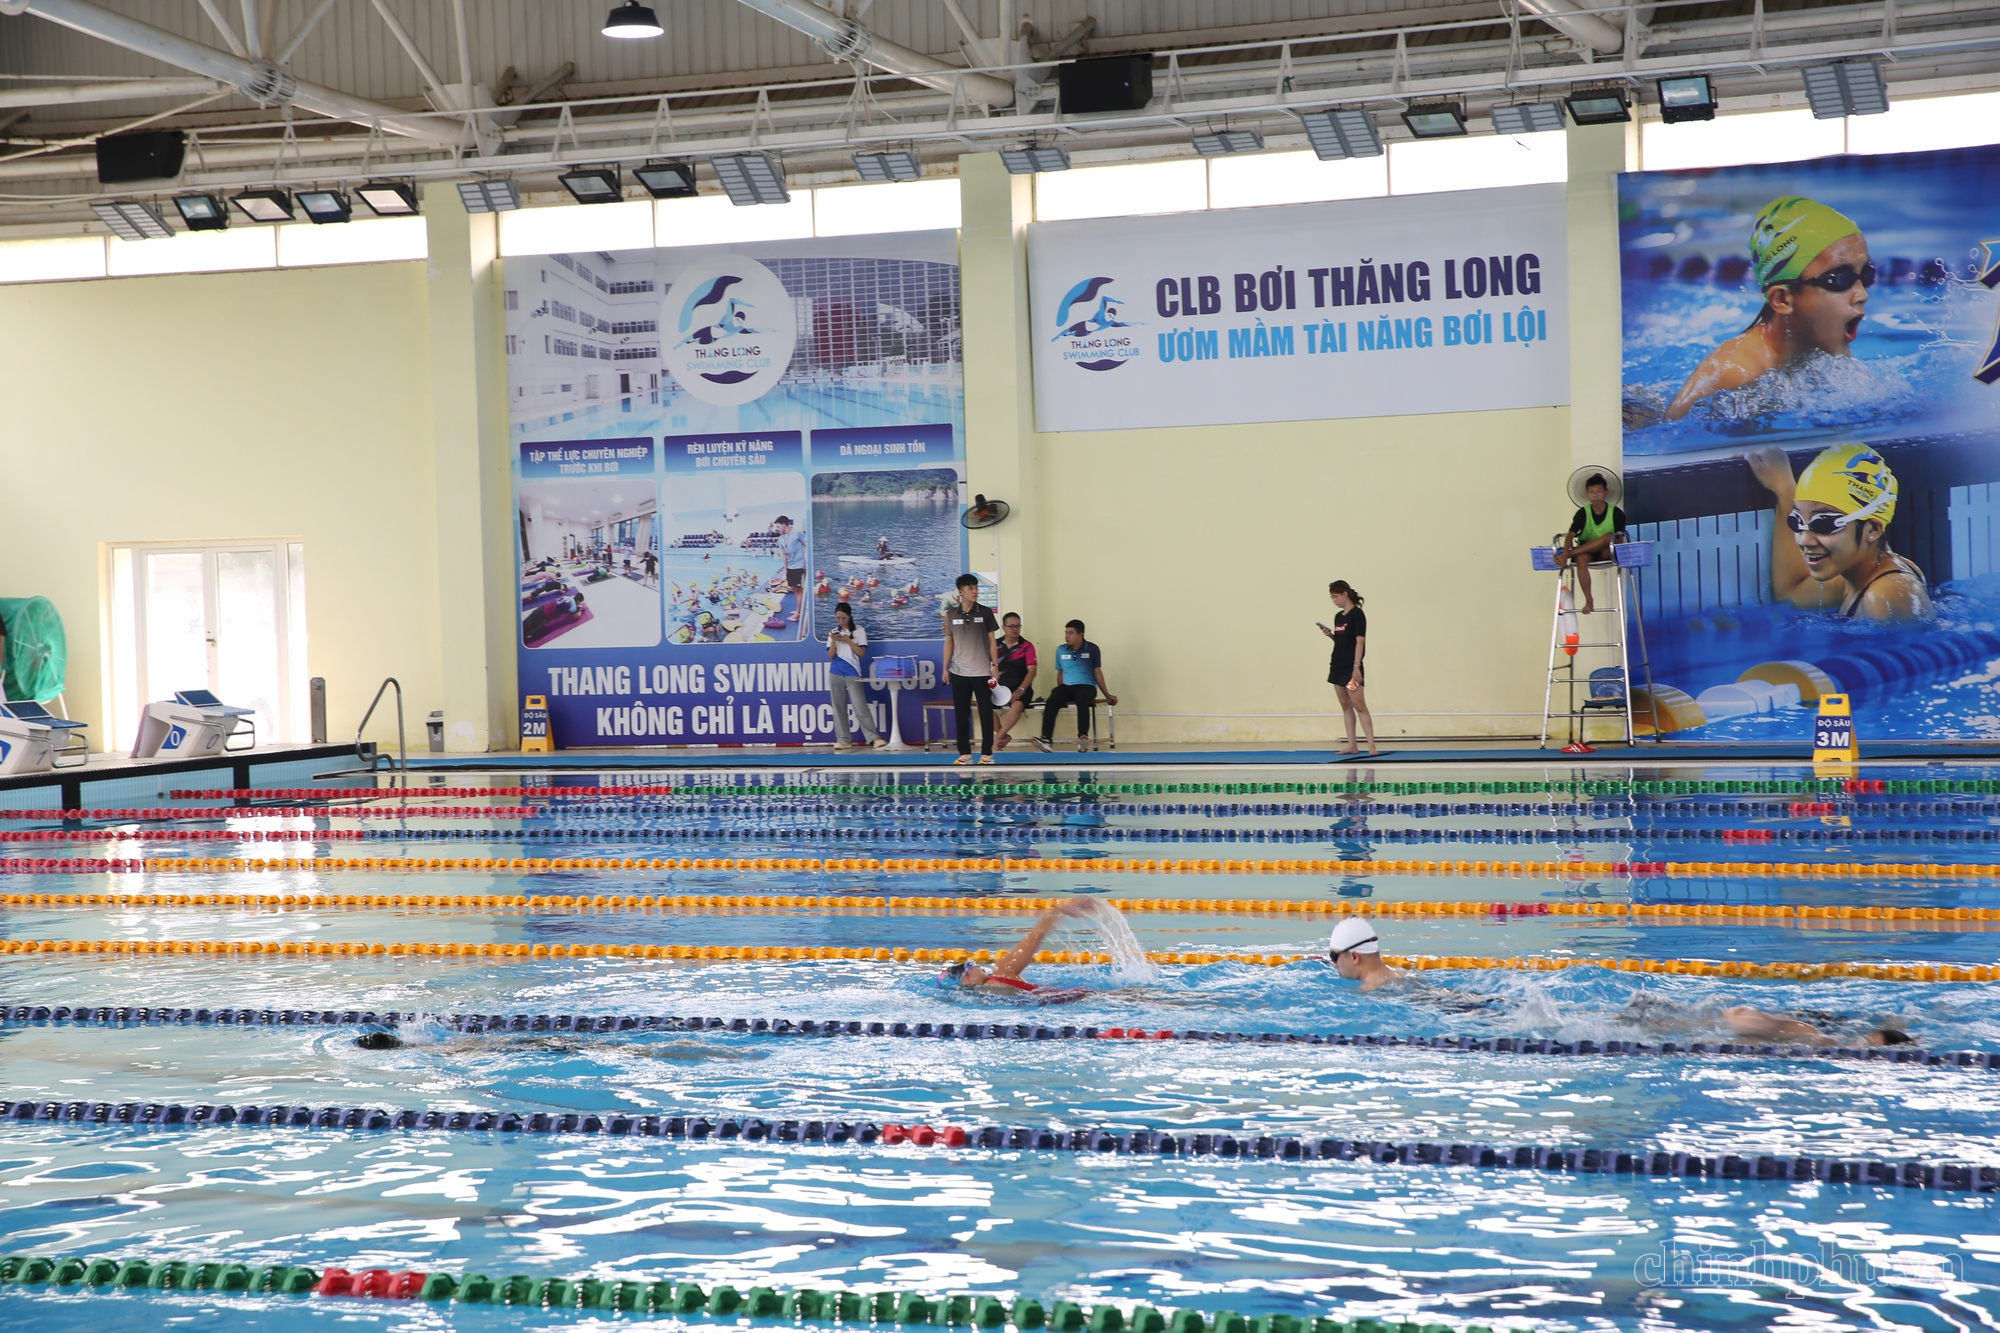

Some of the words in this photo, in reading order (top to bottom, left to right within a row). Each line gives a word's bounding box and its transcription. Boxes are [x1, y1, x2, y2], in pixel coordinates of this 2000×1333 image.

[1772, 236, 1797, 255] LONG
[1156, 275, 1221, 318] CLB
[1234, 265, 1296, 312] BƠI
[1308, 258, 1430, 308] THĂNG
[1445, 253, 1541, 299] LONG
[1158, 327, 1218, 362] ƯƠM
[1228, 317, 1294, 358] MẦM
[1303, 318, 1347, 354] TÀI
[1357, 314, 1433, 351] NĂNG
[1443, 309, 1492, 346] BƠI
[1503, 305, 1546, 347] LỘI
[1104, 338, 1131, 347] LONG
[732, 346, 761, 356] LONG
[1063, 349, 1114, 360] SWIMMING
[1118, 348, 1140, 357] CLUB
[686, 360, 743, 371] SWIMMING
[746, 358, 771, 368] CLUB
[687, 442, 704, 454] RÈN
[707, 440, 733, 456] LUYỆN
[749, 439, 773, 451] NĂNG
[854, 444, 881, 456] NGOẠI
[884, 443, 905, 454] SINH
[529, 450, 546, 464] TẬP
[547, 447, 562, 461] THỂ
[564, 450, 580, 462] LỰC
[582, 447, 615, 460] CHUYÊN
[617, 446, 648, 459] NGHIỆP
[712, 454, 746, 466] CHUYÊN
[748, 453, 766, 465] SÂU
[588, 462, 602, 472] KHI
[1848, 480, 1874, 497] THANG
[548, 666, 631, 696] THANG
[639, 664, 705, 695] LONG
[713, 662, 848, 693] SWIMMI
[597, 700, 684, 736] KHÔNG
[691, 695, 734, 734] CHỈ
[742, 699, 774, 734] LÀ
[782, 704, 834, 740] HỌC
[1818, 719, 1832, 728] ĐỘ
[1833, 719, 1850, 727] SÂU
[523, 722, 545, 734] 2M
[1817, 731, 1849, 747] 3M
